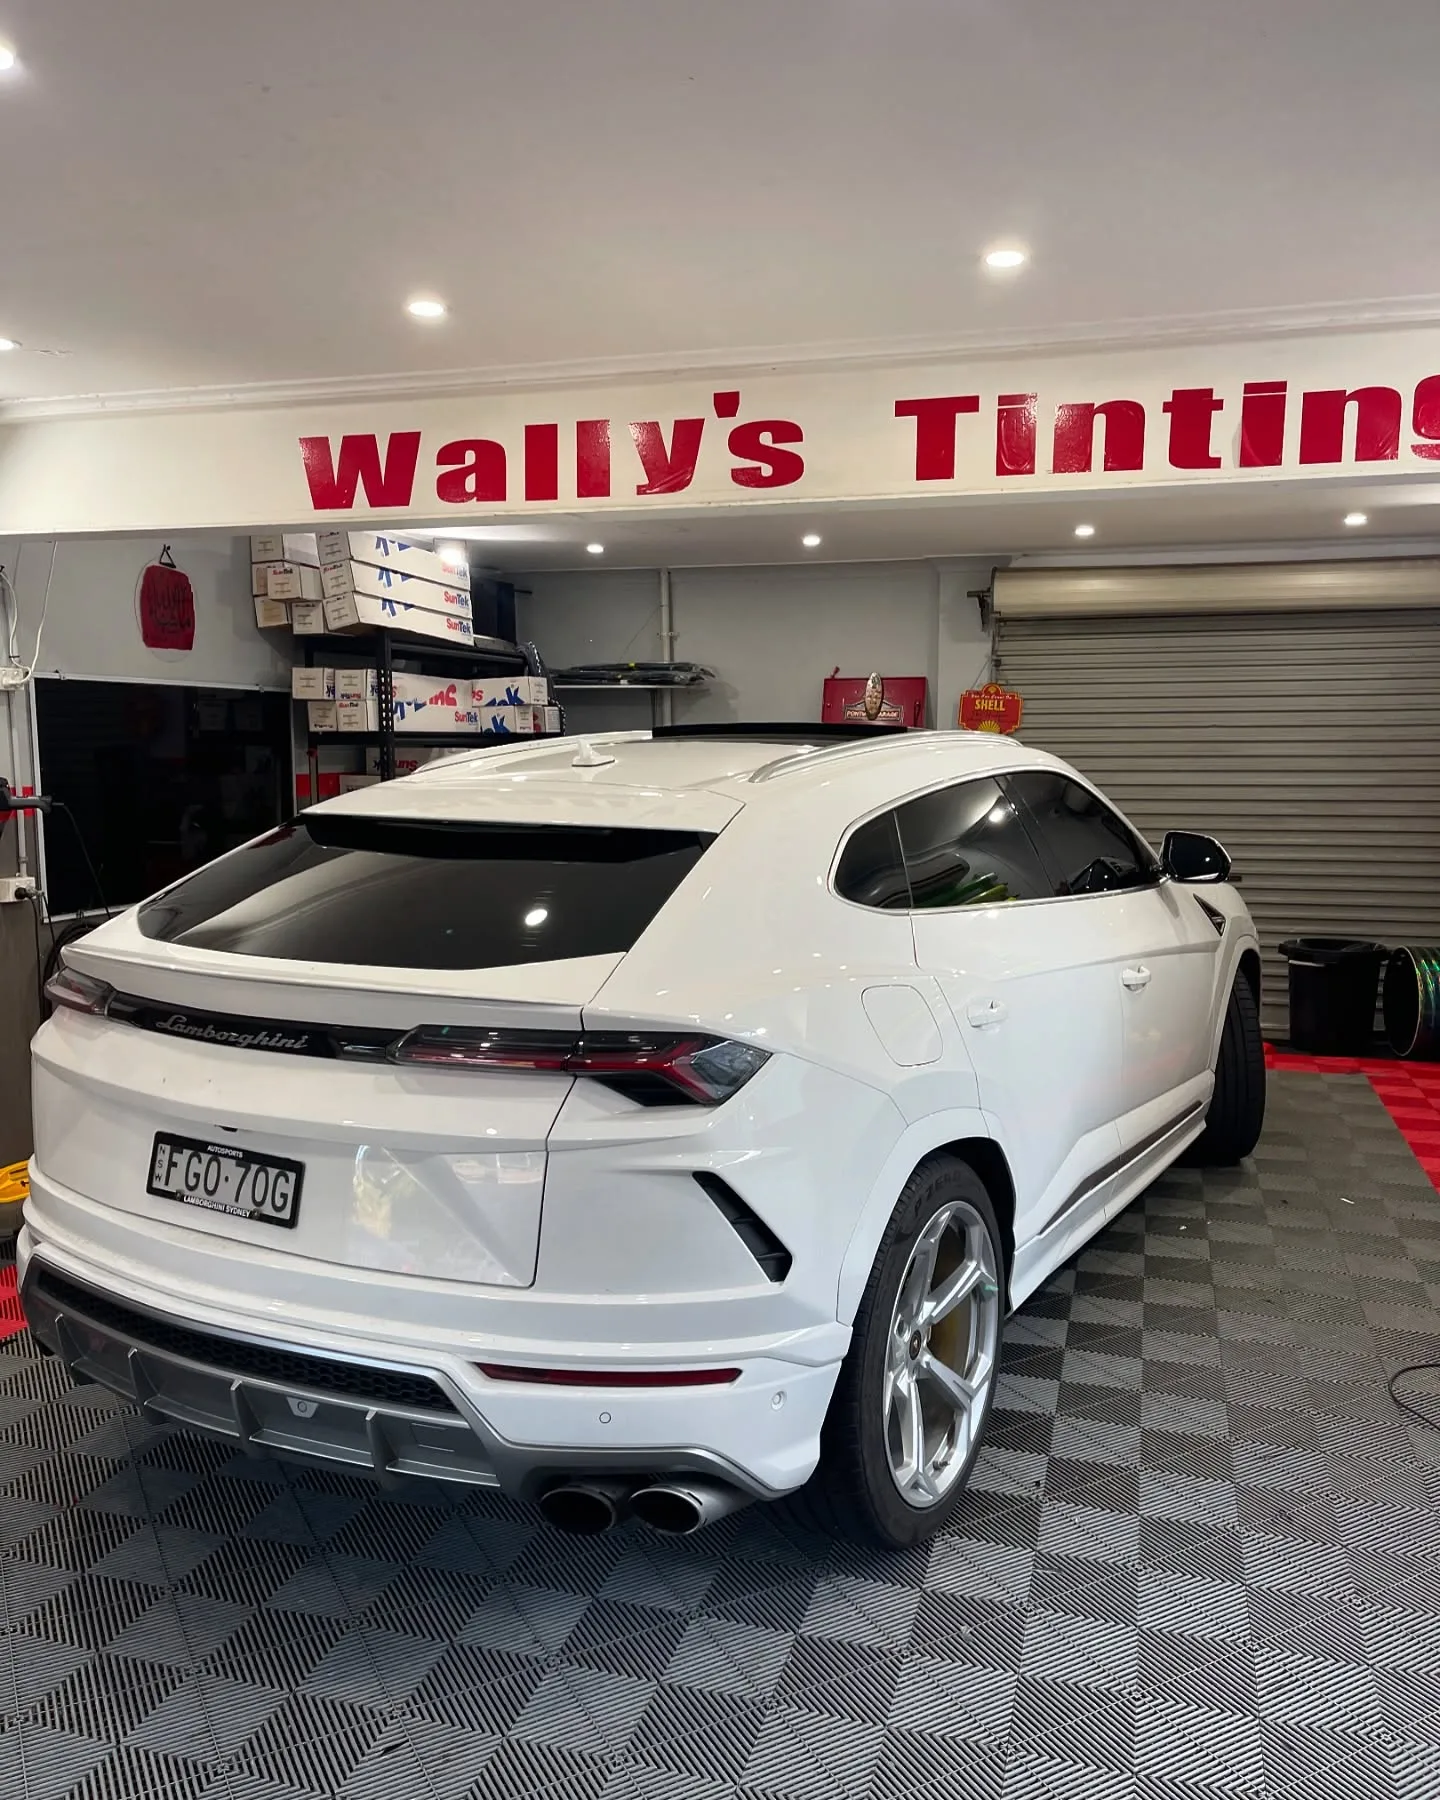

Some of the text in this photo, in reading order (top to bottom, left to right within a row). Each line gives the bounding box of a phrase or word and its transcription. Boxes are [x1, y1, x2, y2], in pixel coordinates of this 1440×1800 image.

[298, 391, 804, 510] Wally's
[443, 591, 470, 607] SunTek
[446, 618, 471, 634] SunTek
[974, 699, 1006, 711] SHELL
[454, 710, 478, 723] SunTek
[156, 1014, 309, 1049] Lamborghini
[207, 1145, 243, 1158] AUTOSPORTS
[183, 1195, 251, 1218] LAMBORGHINI SYDNEY
